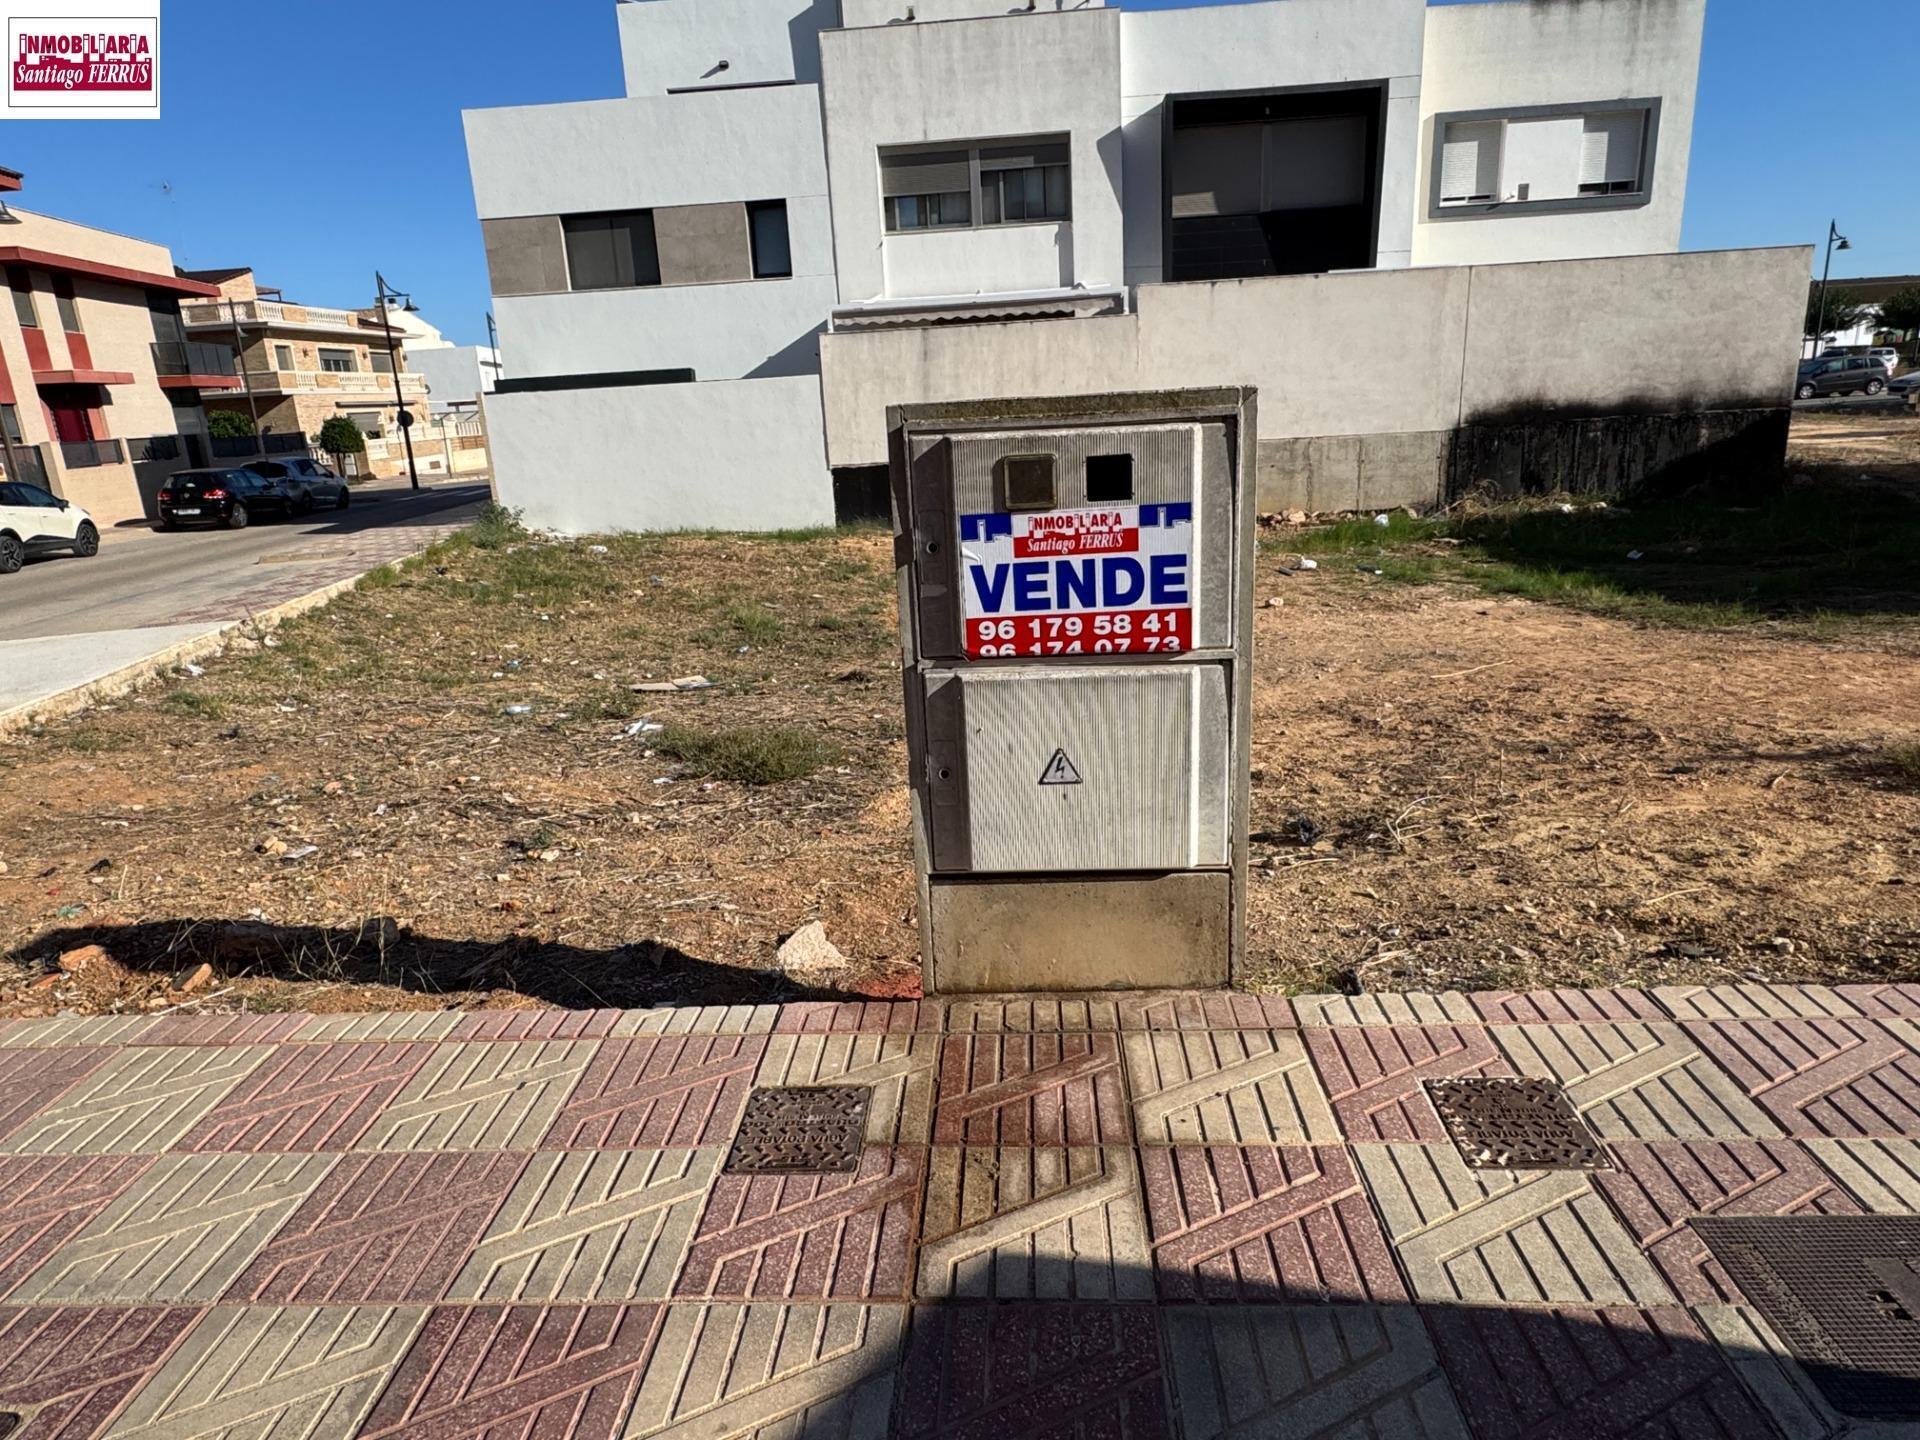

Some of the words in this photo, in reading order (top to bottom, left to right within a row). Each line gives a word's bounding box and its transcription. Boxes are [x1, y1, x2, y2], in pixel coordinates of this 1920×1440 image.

[1027, 538, 1075, 554] Santiago
[1079, 532, 1123, 549] FERRUS
[970, 554, 1188, 612] VENDE
[978, 620, 1016, 640] 96
[1028, 617, 1083, 638] 179
[1093, 614, 1132, 635] 58
[1142, 612, 1177, 632] 41
[1143, 636, 1180, 653] 73
